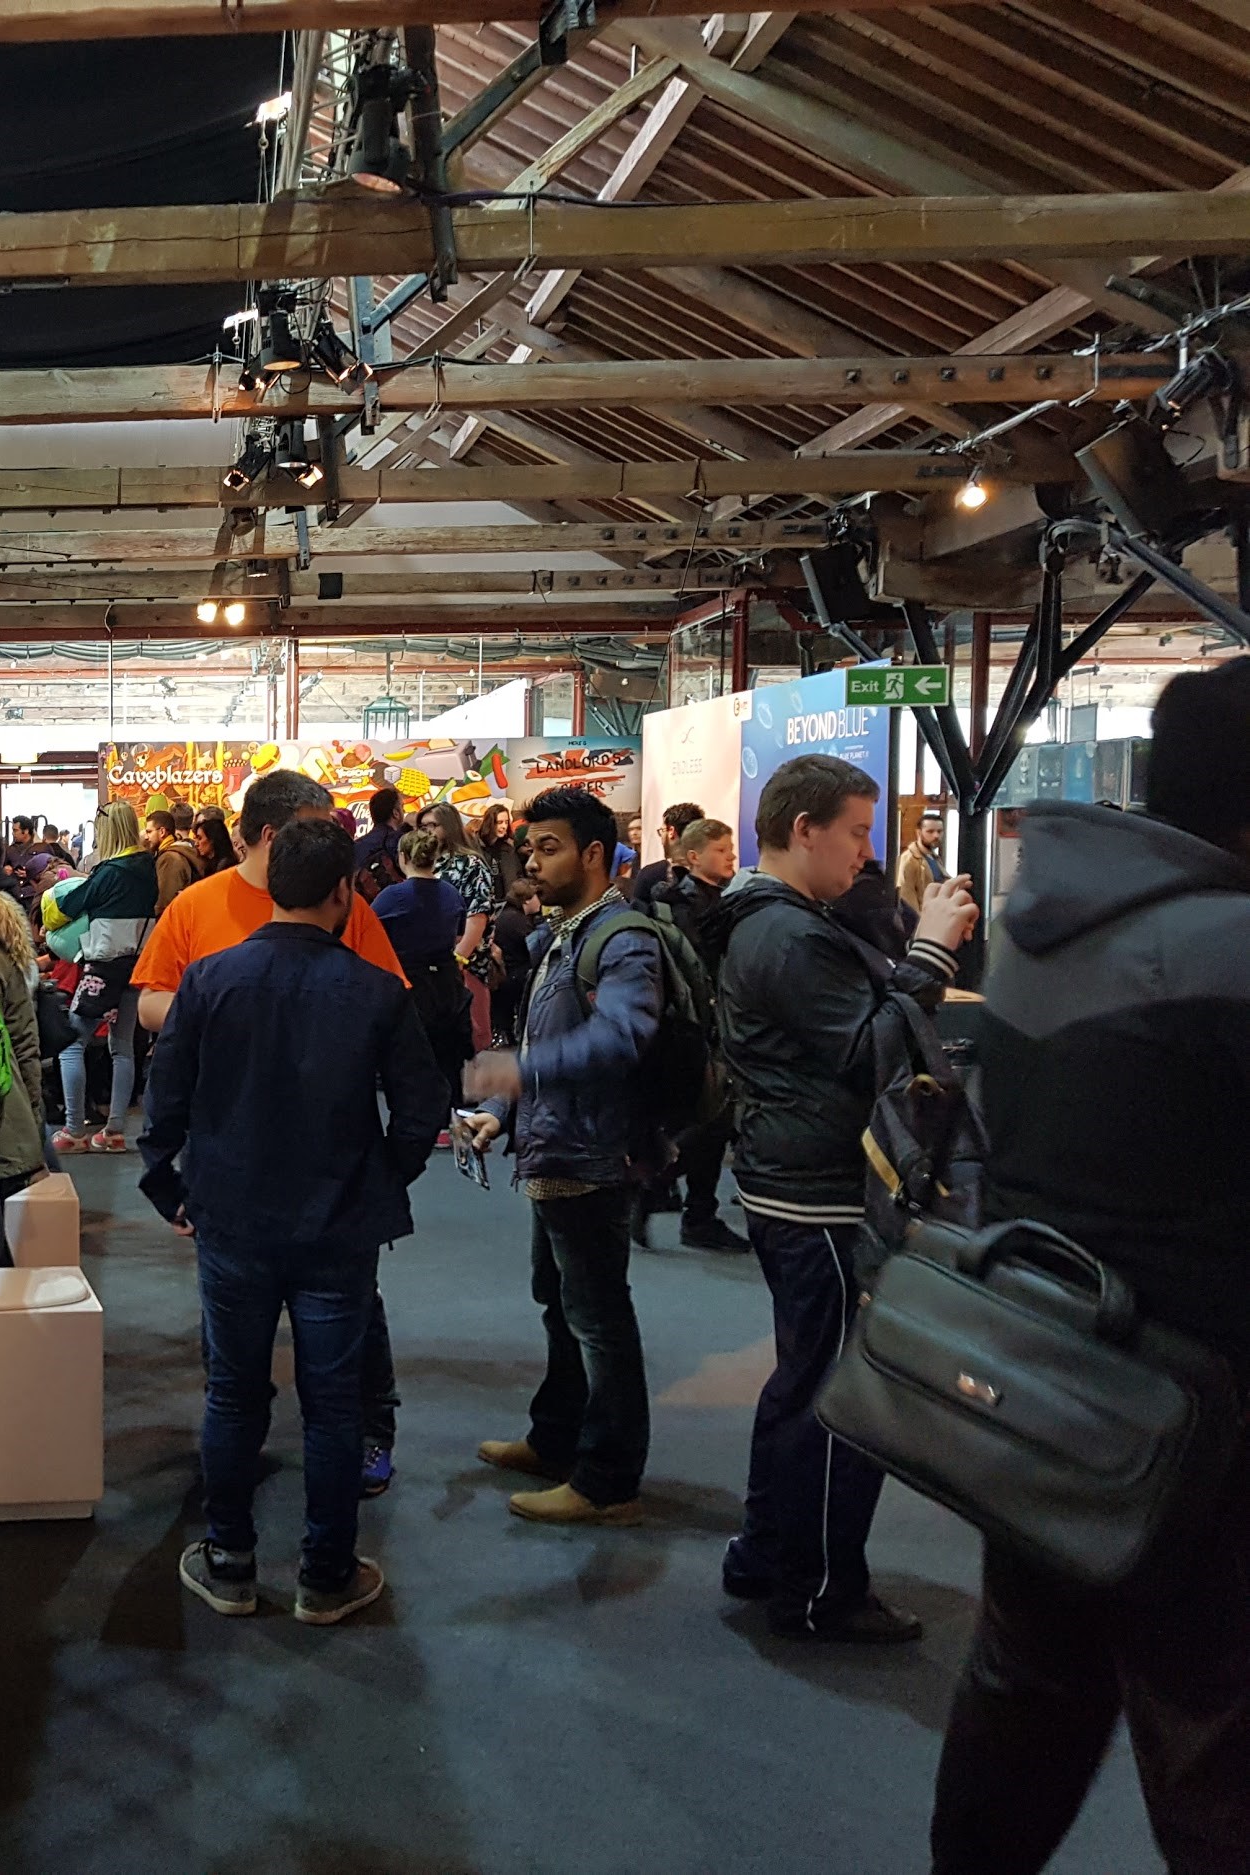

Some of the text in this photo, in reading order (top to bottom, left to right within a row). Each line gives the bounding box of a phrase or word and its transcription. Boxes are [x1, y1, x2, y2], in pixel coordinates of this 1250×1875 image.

[851, 680, 879, 693] Exit
[787, 706, 869, 745] BEYOND BLUE
[107, 765, 223, 791] Caveblazers
